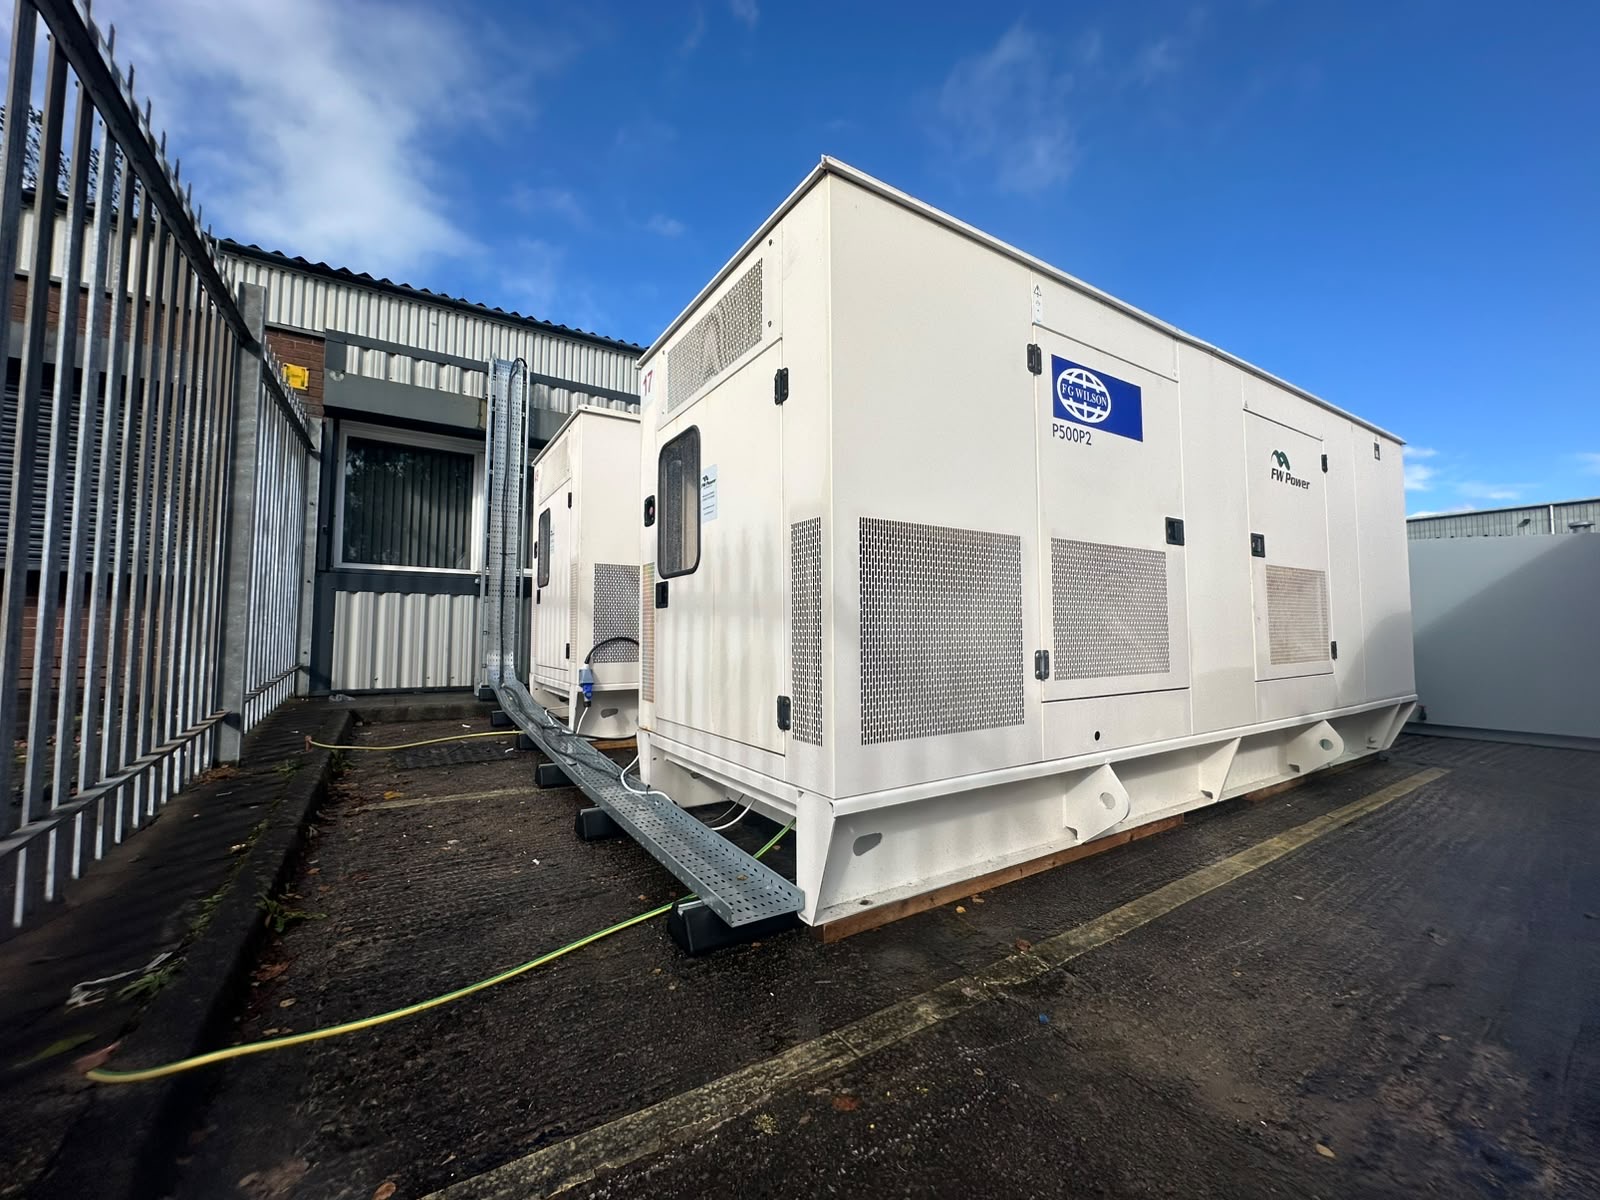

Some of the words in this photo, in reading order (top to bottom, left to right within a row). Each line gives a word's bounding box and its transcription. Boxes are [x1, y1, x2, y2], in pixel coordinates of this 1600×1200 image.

[643, 369, 653, 396] 17
[1062, 383, 1074, 397] FG
[1075, 387, 1107, 407] WILSON
[1052, 423, 1092, 446] P500P2
[1271, 468, 1285, 482] FW
[1285, 472, 1310, 490] Power
